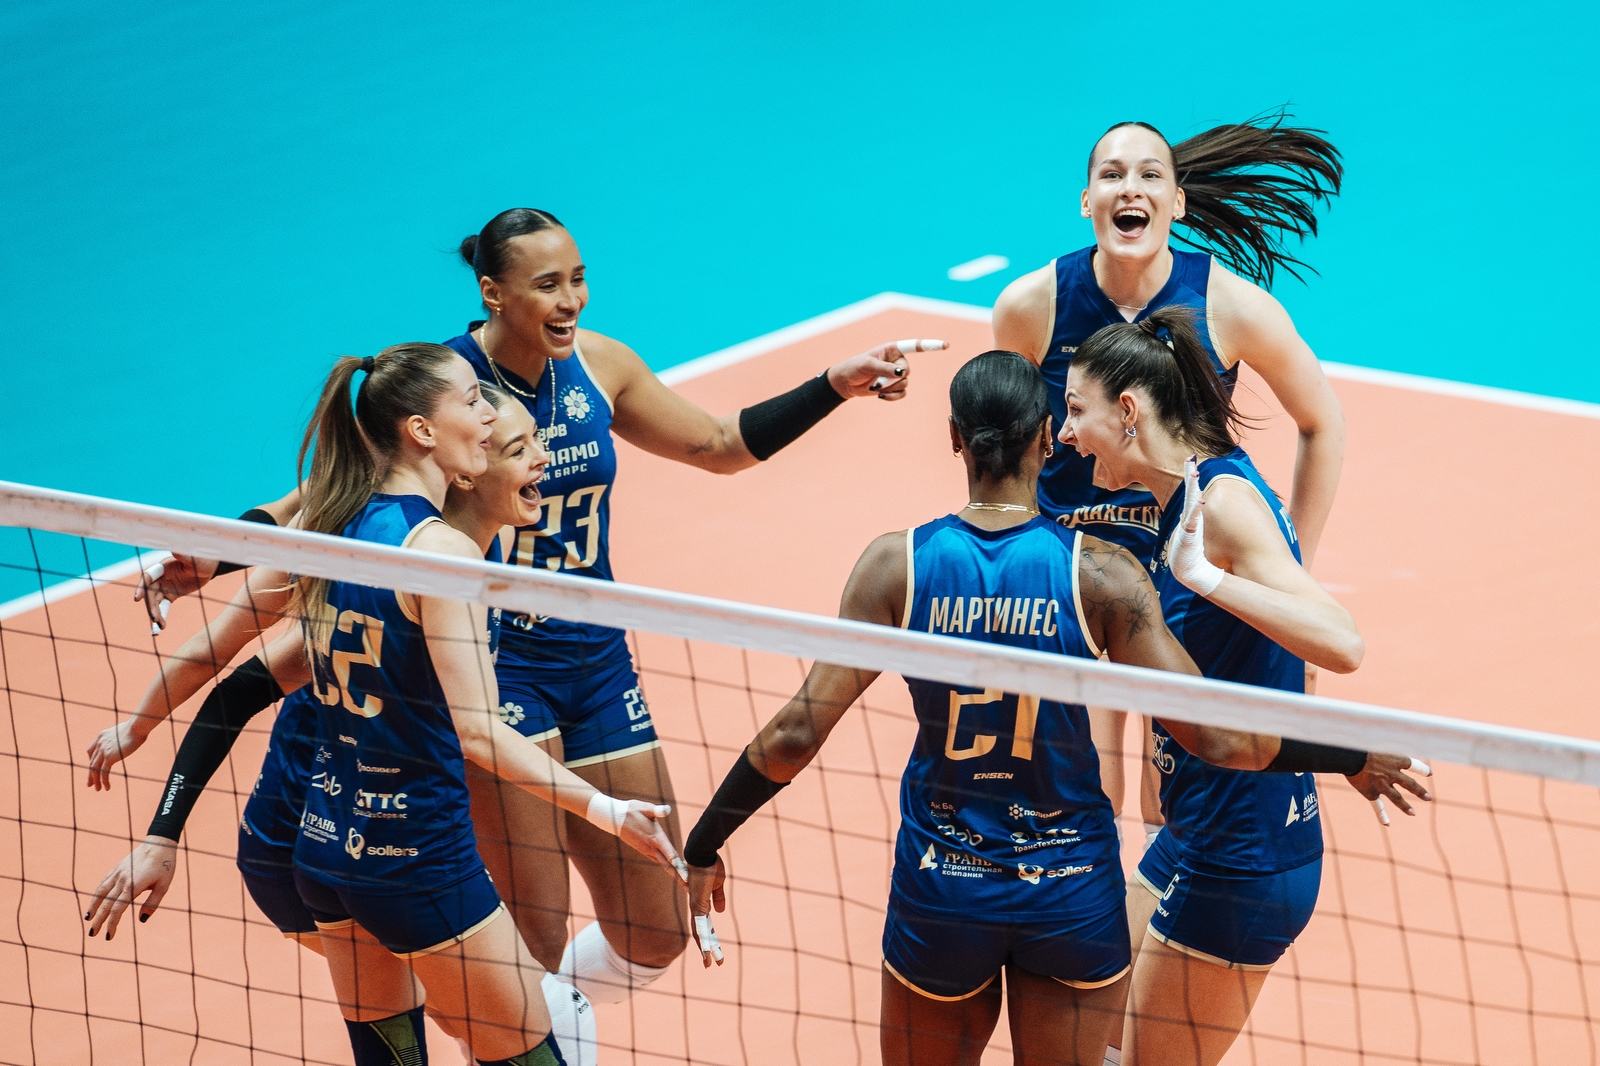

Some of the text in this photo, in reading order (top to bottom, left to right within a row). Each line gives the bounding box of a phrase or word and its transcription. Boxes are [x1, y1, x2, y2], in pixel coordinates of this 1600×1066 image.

[545, 440, 600, 469] НАМО
[554, 463, 588, 478] БАРС
[516, 484, 608, 573] 23
[928, 596, 1060, 637] МАРТИНЕС
[973, 772, 1014, 780] ENSEN
[161, 773, 185, 816] MIKASA
[306, 812, 337, 833] ГРАНЬ
[366, 844, 419, 857] sollers
[1013, 836, 1082, 853] ТрансТехСервис
[942, 869, 984, 879] компания
[943, 863, 1003, 873] строительная
[1046, 864, 1094, 878] sollers
